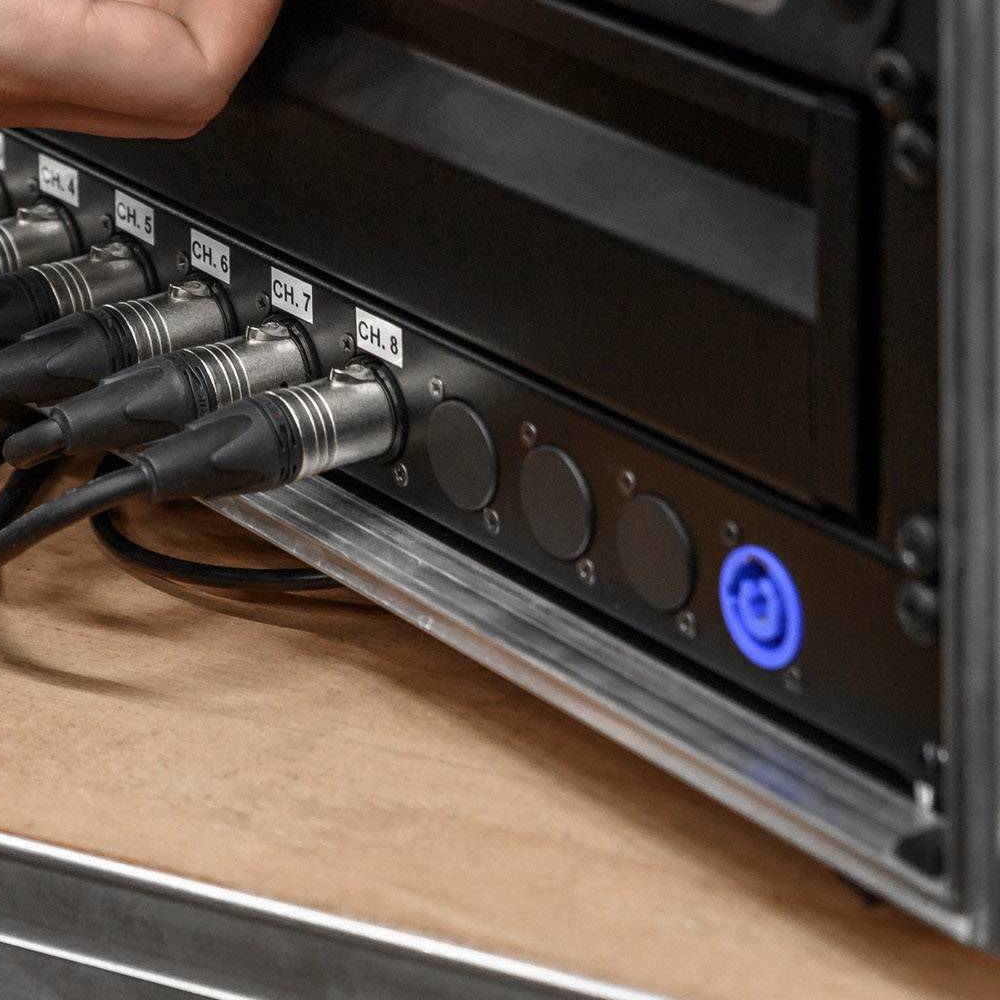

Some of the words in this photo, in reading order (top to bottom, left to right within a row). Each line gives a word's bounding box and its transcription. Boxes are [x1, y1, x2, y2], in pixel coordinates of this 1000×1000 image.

[40, 165, 65, 192] CH.
[67, 177, 76, 197] 4
[116, 200, 140, 229] CH.
[144, 215, 152, 234] 5
[191, 240, 217, 269] CH.
[220, 254, 229, 274] 6
[273, 279, 299, 308] CH.
[302, 291, 311, 313] 7
[358, 320, 385, 350] CH.
[390, 335, 398, 355] 8
